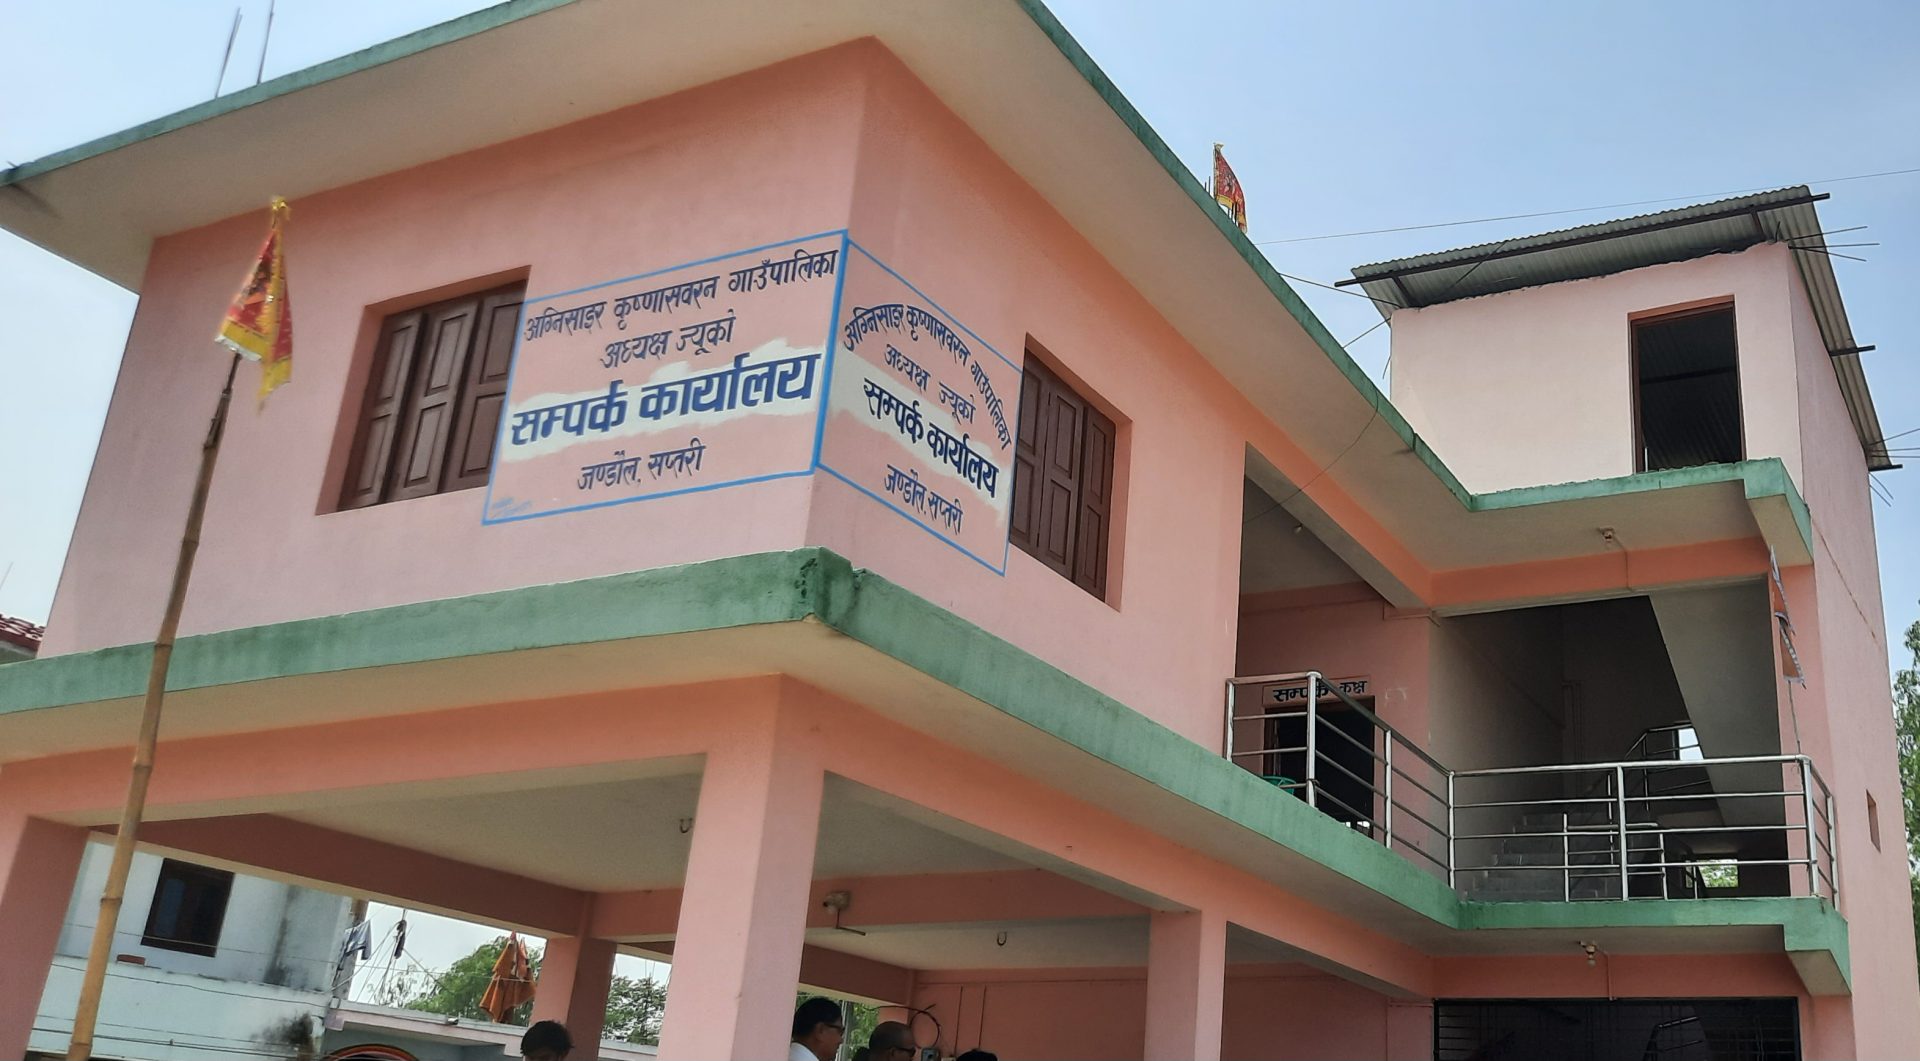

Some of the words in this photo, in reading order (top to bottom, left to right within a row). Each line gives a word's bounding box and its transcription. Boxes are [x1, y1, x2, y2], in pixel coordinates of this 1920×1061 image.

[612, 276, 721, 331] कृष्णासवरन
[728, 249, 839, 294] गाउँपालिका
[600, 329, 673, 369] अध्यक्ष
[676, 308, 737, 356] ज्यूको
[511, 380, 629, 447] सम्पर्क
[638, 352, 822, 421] कार्यालय
[884, 343, 932, 394] अध्यक्ष
[939, 381, 976, 425] ज्यूको
[647, 437, 706, 480] सप्तरी
[863, 377, 924, 444] सम्पर्क
[927, 422, 1000, 498] कार्यालय
[928, 491, 964, 536] सप्तरी
